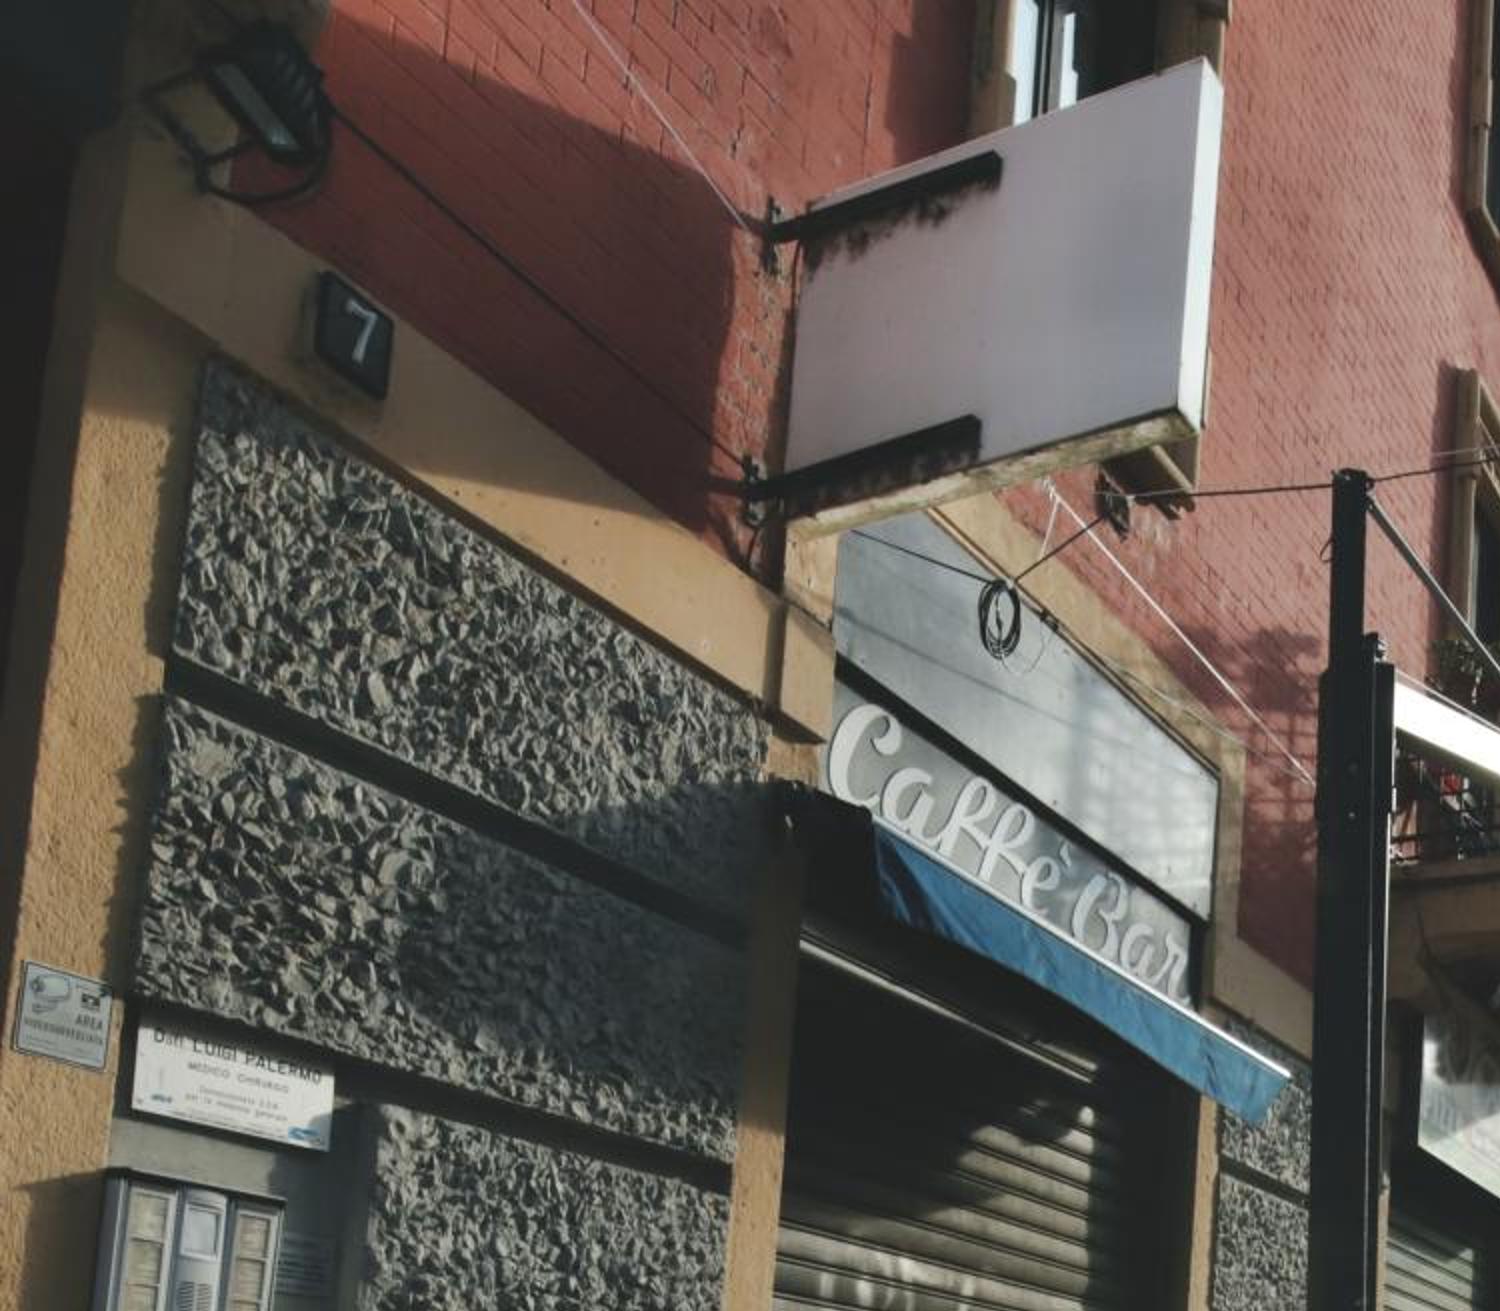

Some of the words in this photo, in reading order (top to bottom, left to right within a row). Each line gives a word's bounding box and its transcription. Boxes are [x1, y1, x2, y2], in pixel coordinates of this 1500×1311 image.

[345, 298, 378, 365] 7
[827, 702, 1073, 917] Caffè
[1071, 872, 1192, 1010] Bar
[75, 1014, 103, 1031] AREA
[192, 1039, 238, 1063] LUIGI
[244, 1048, 323, 1086] PALERMO
